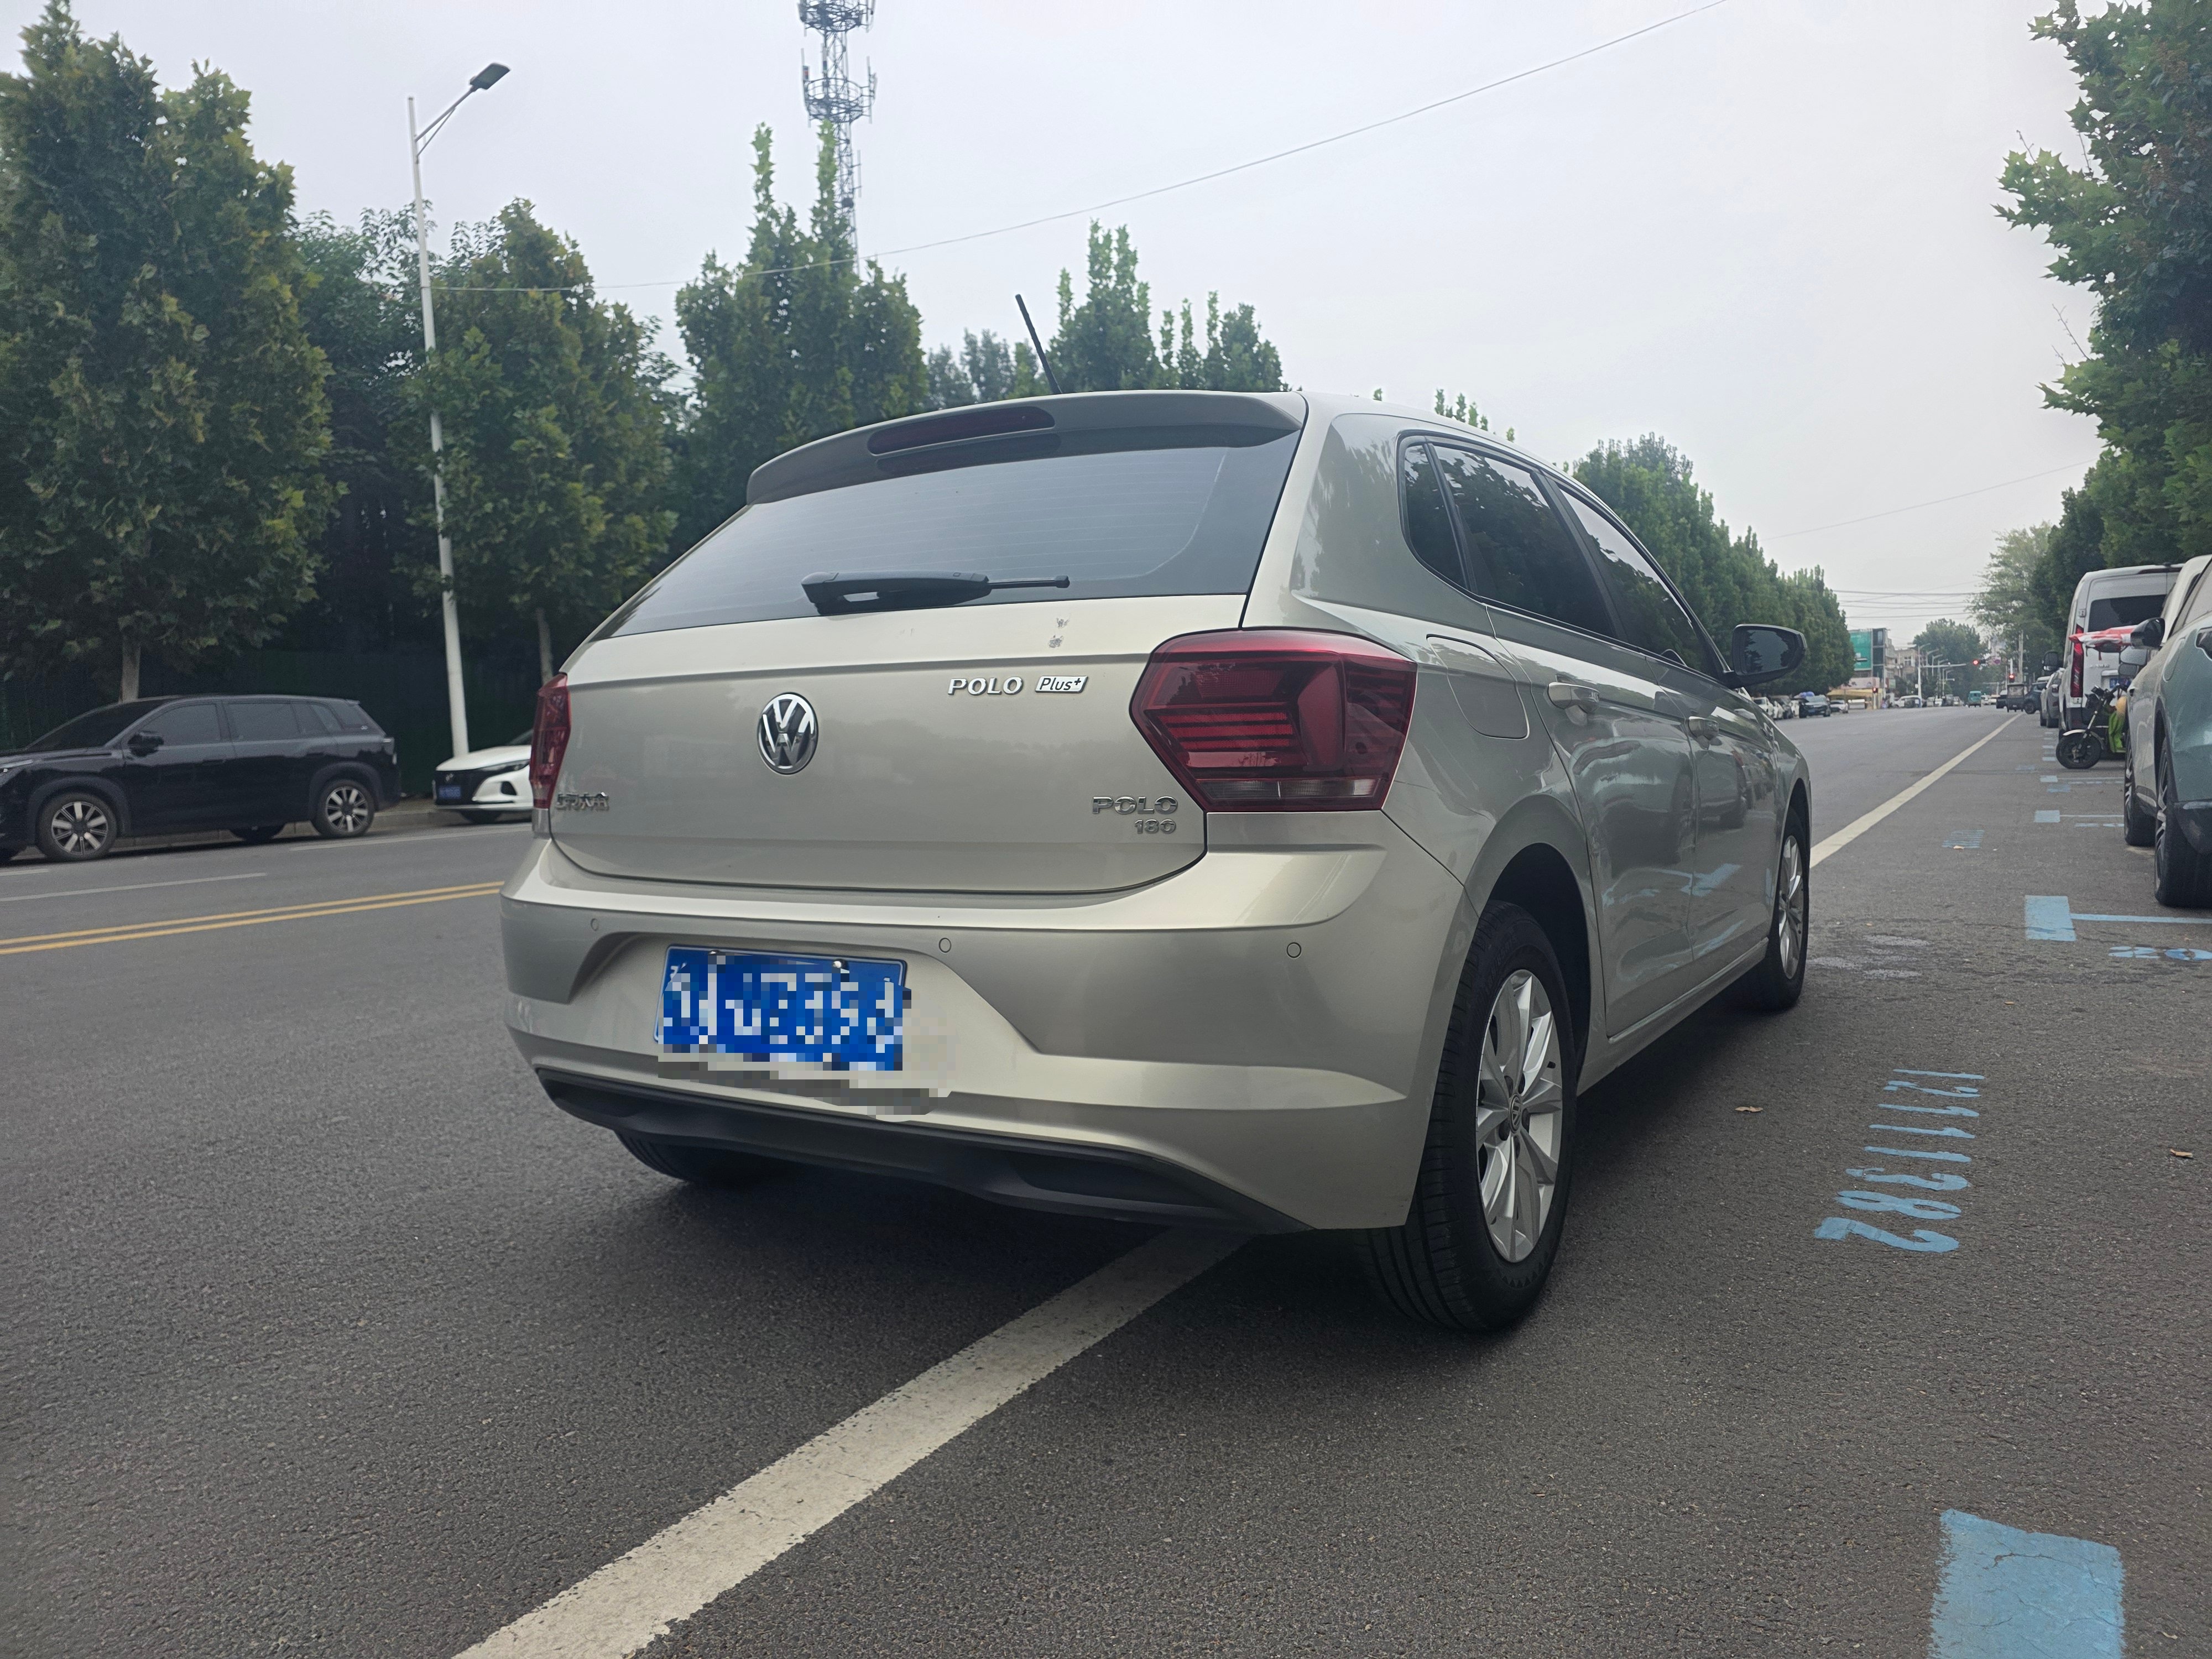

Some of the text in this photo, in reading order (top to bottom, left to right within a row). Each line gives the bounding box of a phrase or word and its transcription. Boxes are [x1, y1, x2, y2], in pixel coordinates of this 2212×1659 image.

[947, 676, 1024, 696] POLO
[1092, 796, 1178, 815] POLO
[1134, 818, 1176, 834] 180
